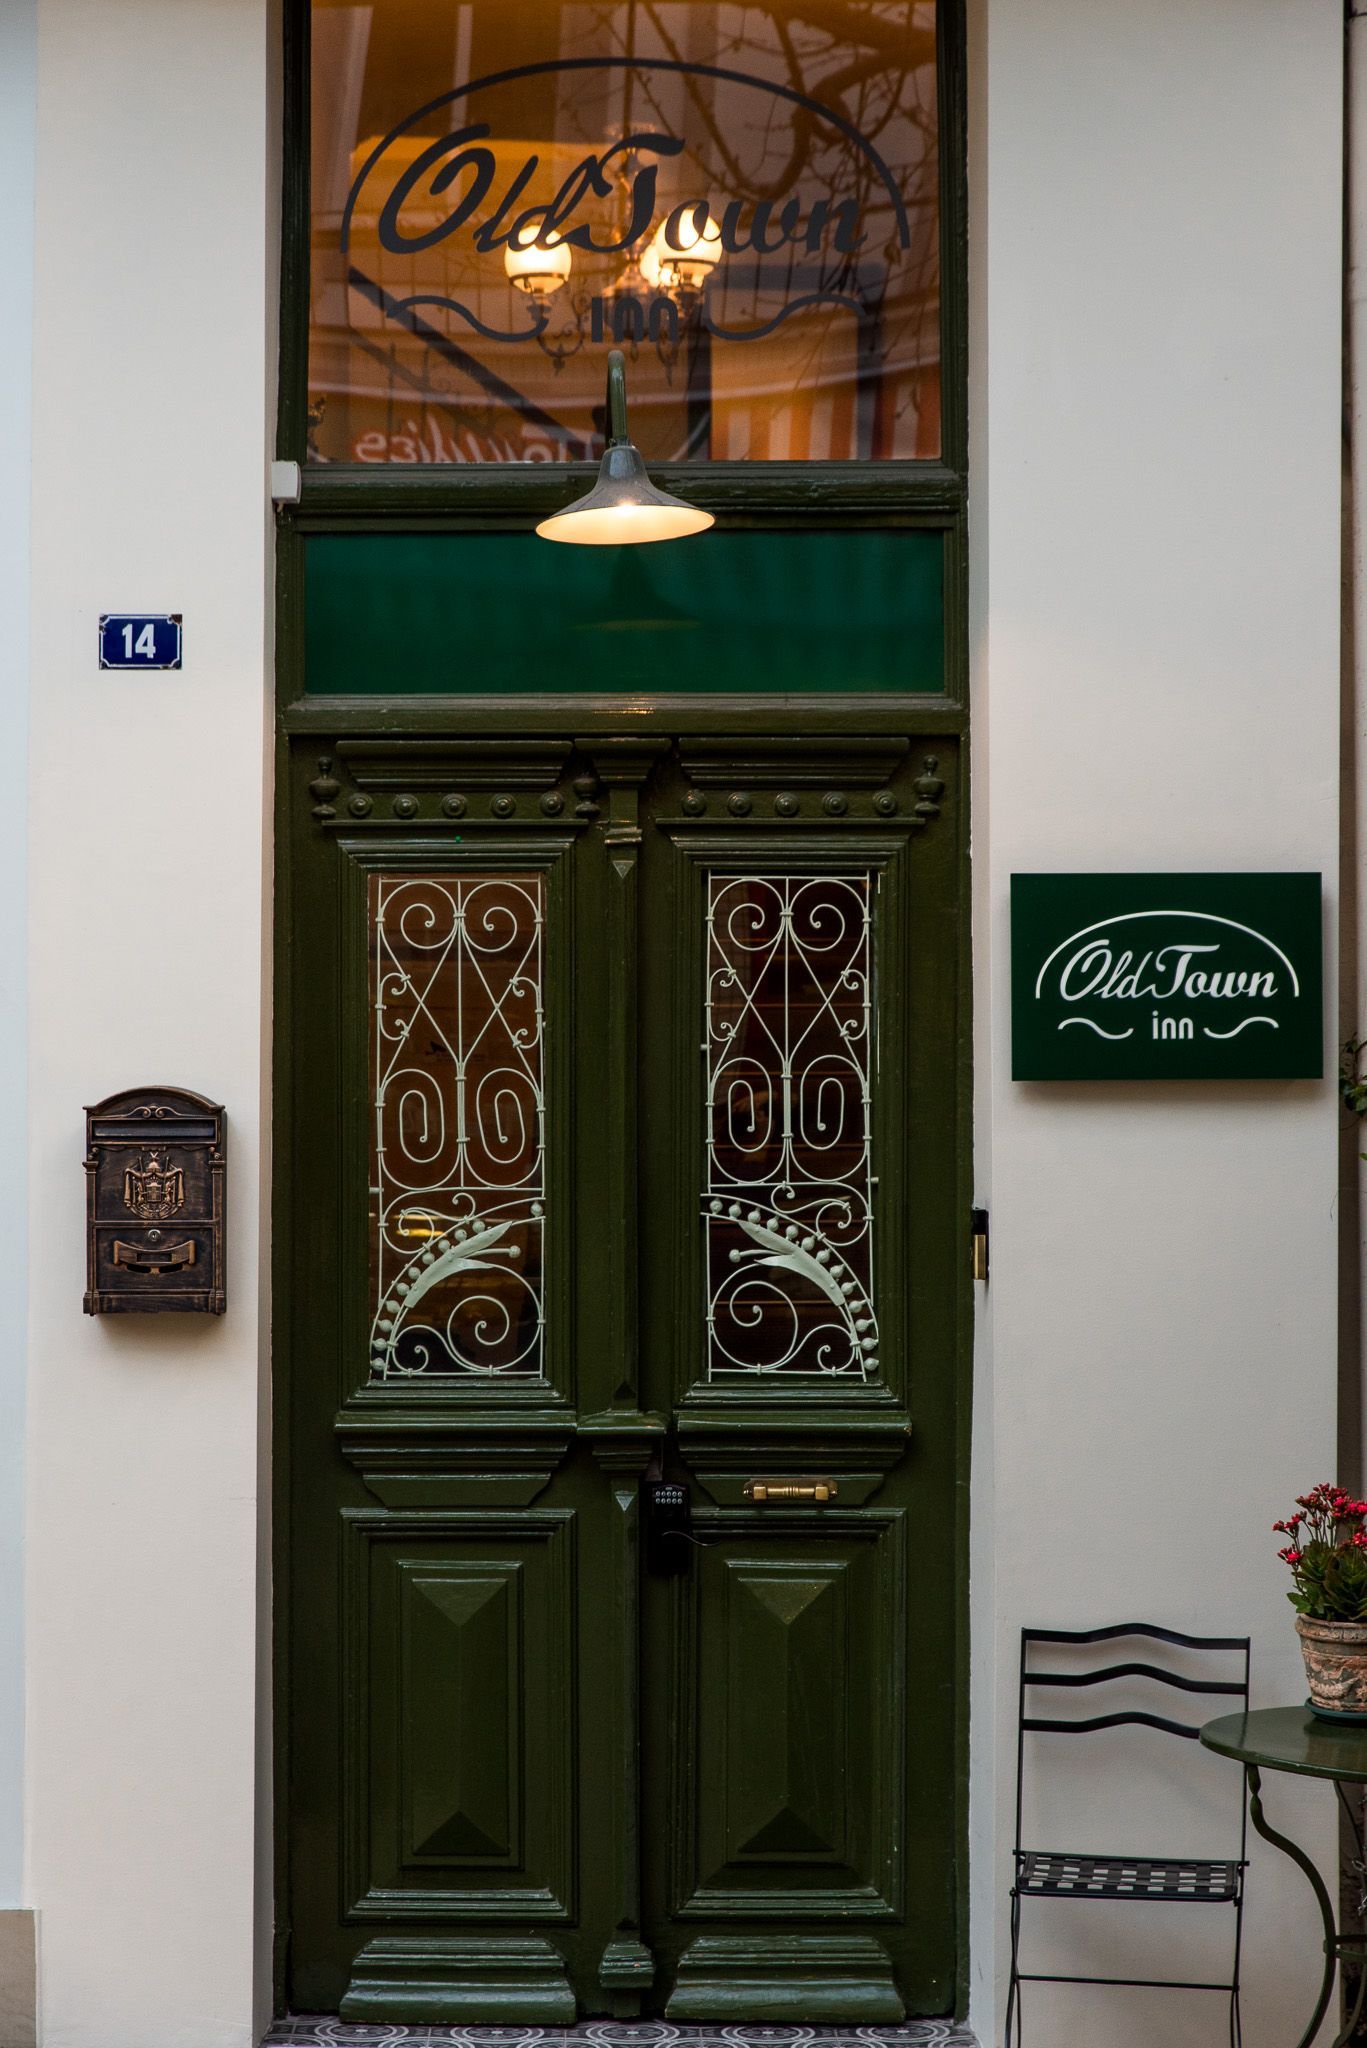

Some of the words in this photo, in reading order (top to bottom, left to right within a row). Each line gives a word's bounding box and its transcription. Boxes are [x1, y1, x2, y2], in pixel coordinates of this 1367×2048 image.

[378, 123, 597, 254] Old
[571, 133, 868, 254] Town
[122, 623, 156, 659] 14
[1060, 939, 1153, 1001] Old
[1152, 944, 1278, 999] Town
[1152, 1010, 1194, 1040] inn
